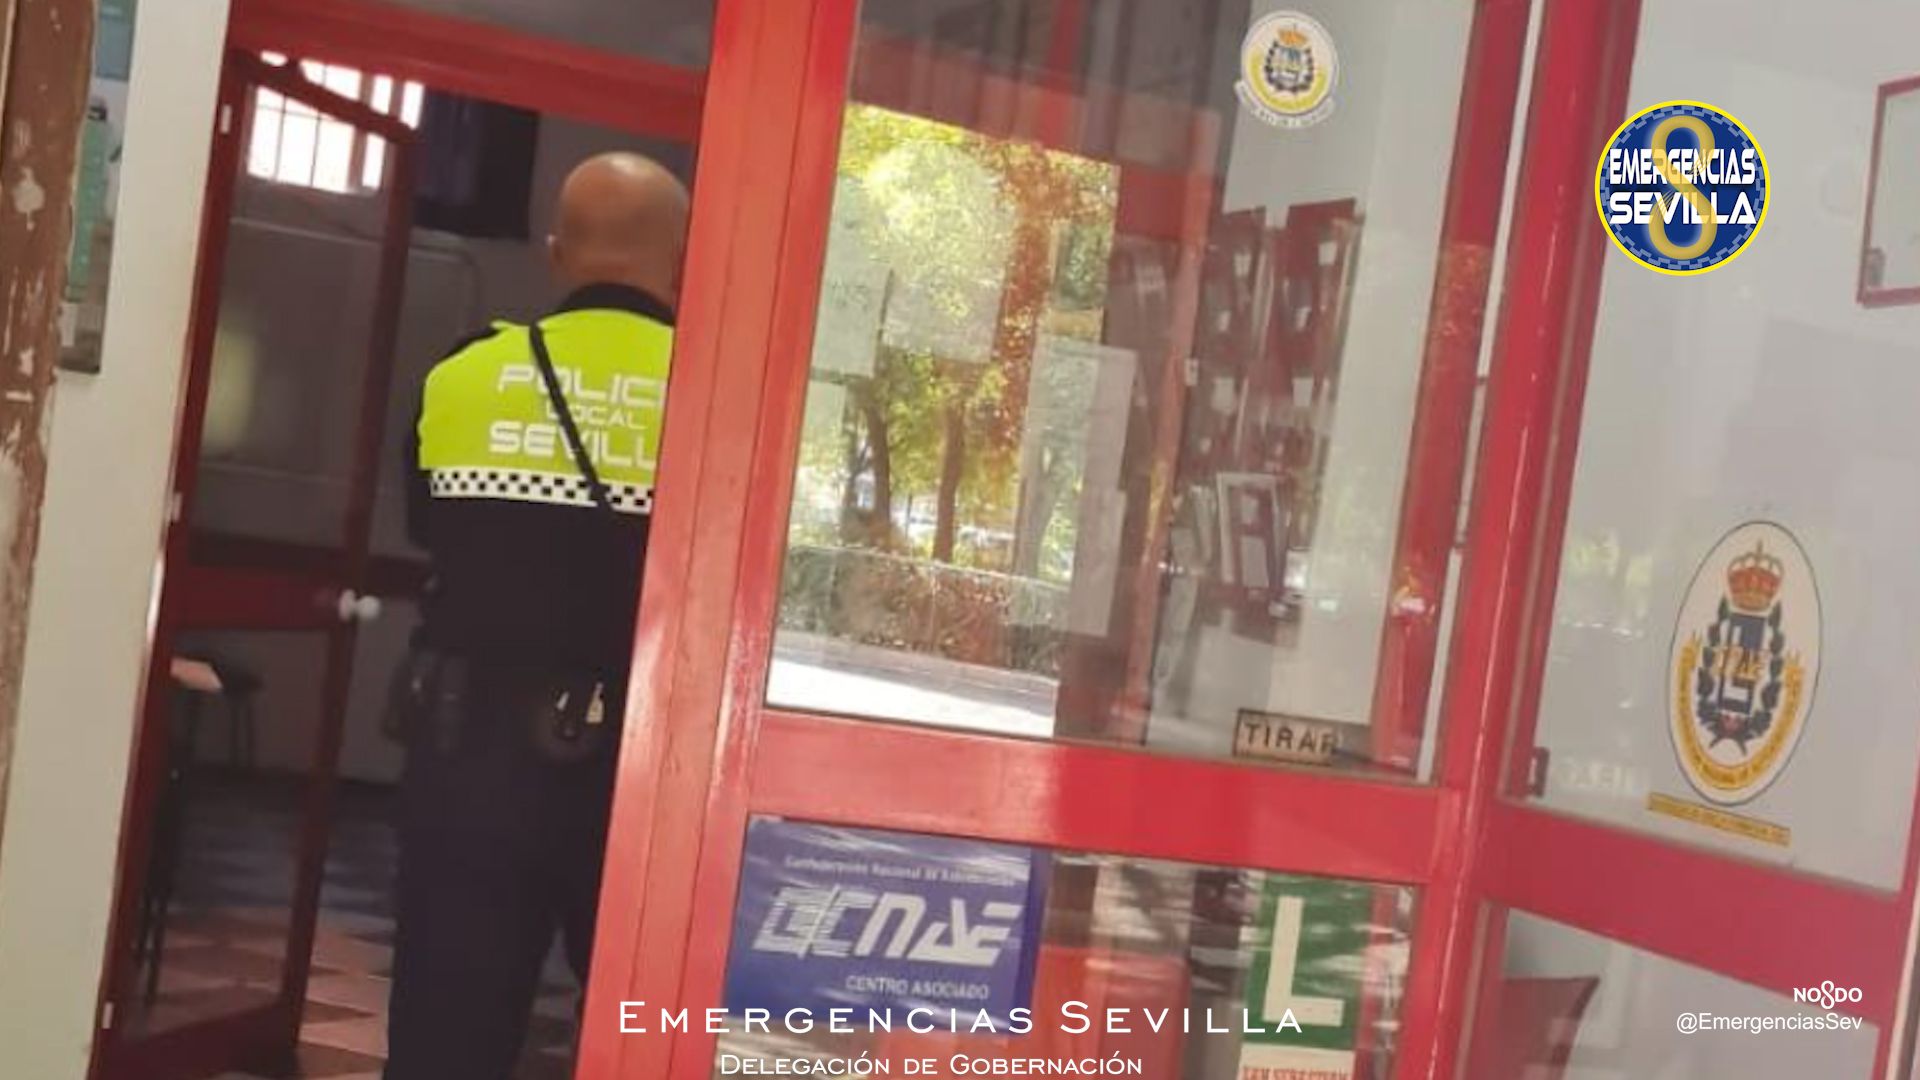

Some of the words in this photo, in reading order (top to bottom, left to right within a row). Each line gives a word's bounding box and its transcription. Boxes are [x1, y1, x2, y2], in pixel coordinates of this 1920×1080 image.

[546, 401, 648, 430] LOCAL
[845, 974, 908, 996] CENTRO
[911, 979, 989, 1000] ASOCIADO
